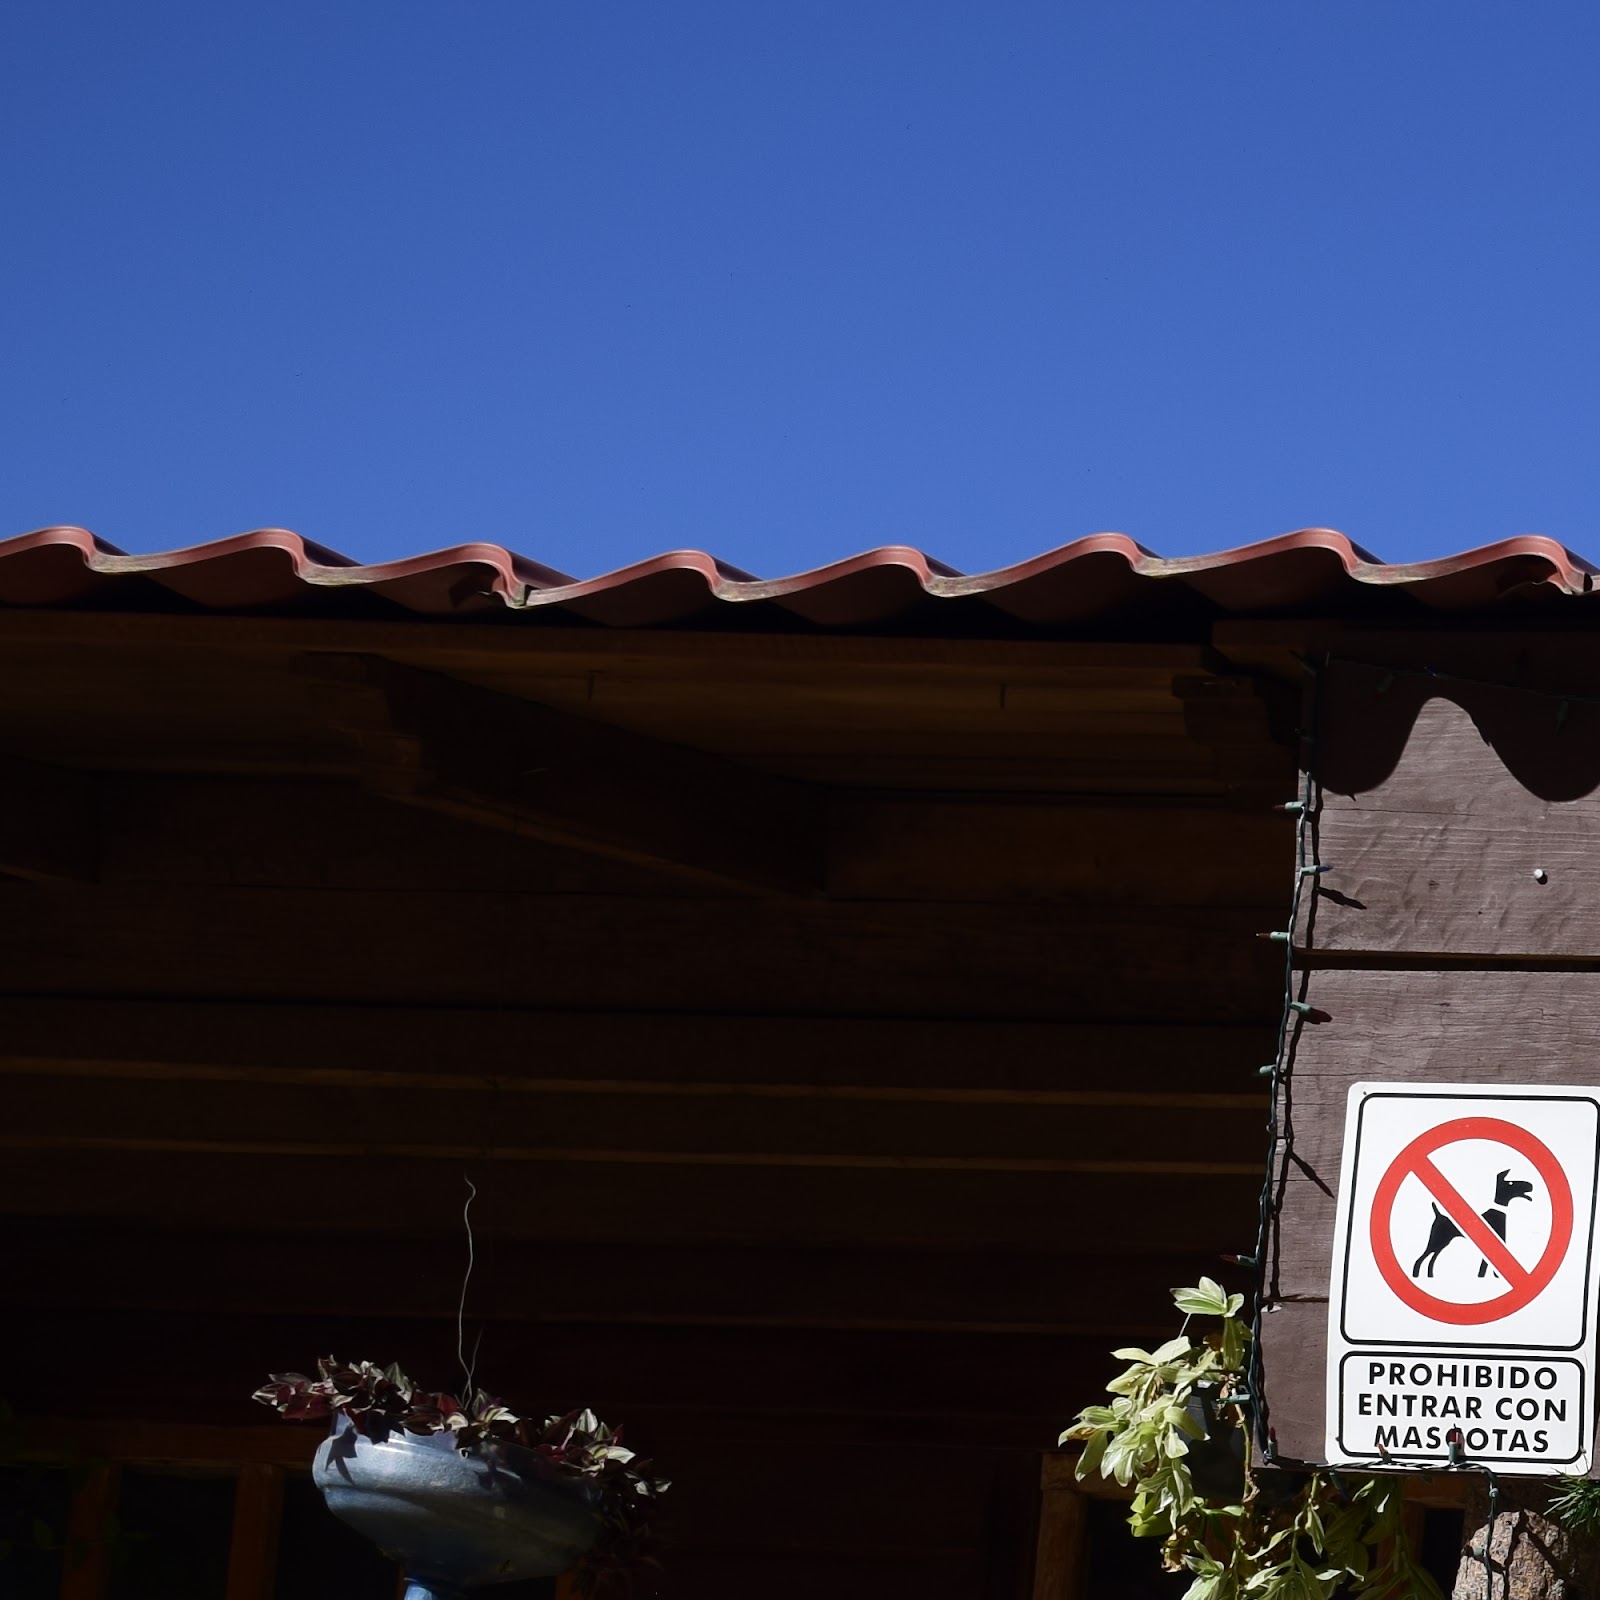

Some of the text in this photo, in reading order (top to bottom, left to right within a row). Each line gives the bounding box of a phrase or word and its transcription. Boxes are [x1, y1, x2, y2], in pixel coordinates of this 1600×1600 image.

[1368, 1361, 1558, 1391] PROHIBIDO
[1358, 1393, 1567, 1421] ENTRAR CON
